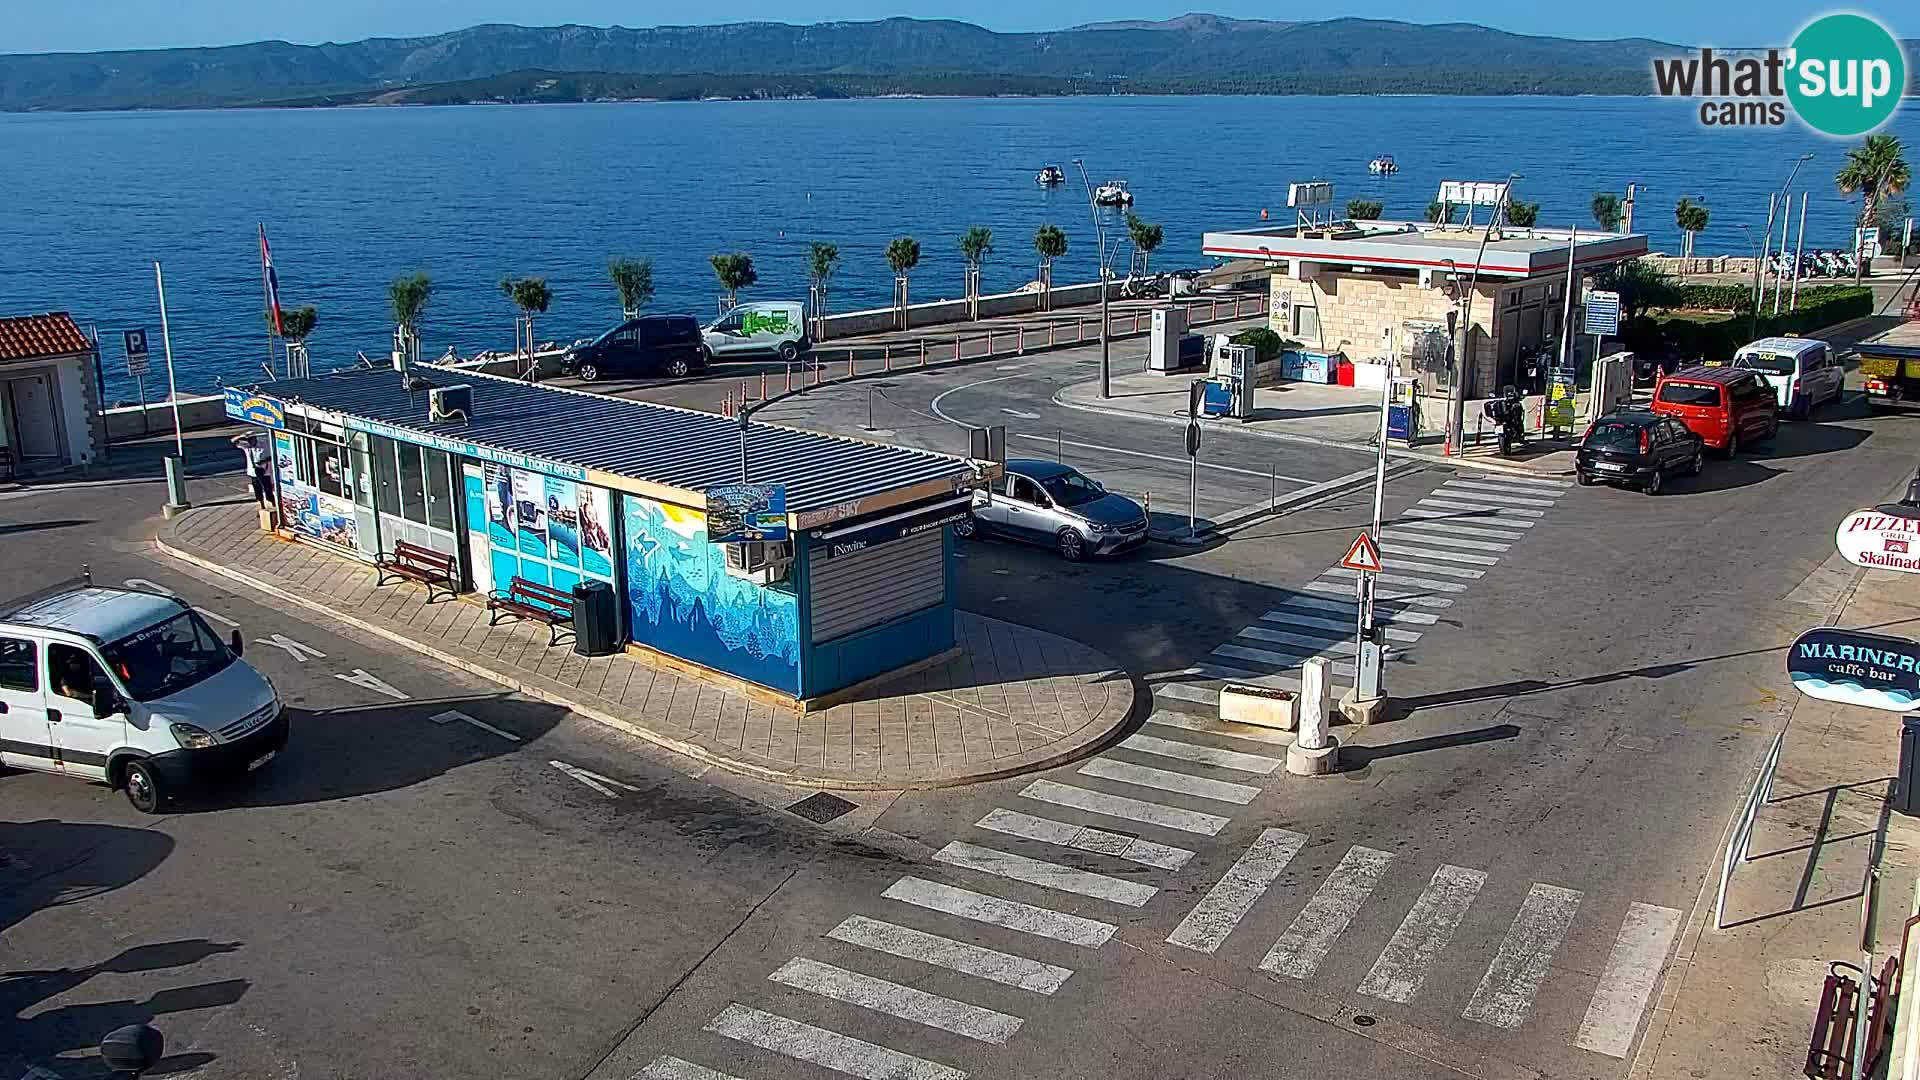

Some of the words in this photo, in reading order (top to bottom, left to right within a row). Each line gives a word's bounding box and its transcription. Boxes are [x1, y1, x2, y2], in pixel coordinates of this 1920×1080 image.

[129, 333, 142, 352] P
[492, 451, 525, 467] STATION
[529, 459, 552, 473] TICKET
[554, 464, 581, 479] OFFICE
[1848, 516, 1920, 535] PIZZE
[1881, 531, 1916, 541] GRILL
[1828, 663, 1865, 677] caffe
[1869, 666, 1896, 681] bar
